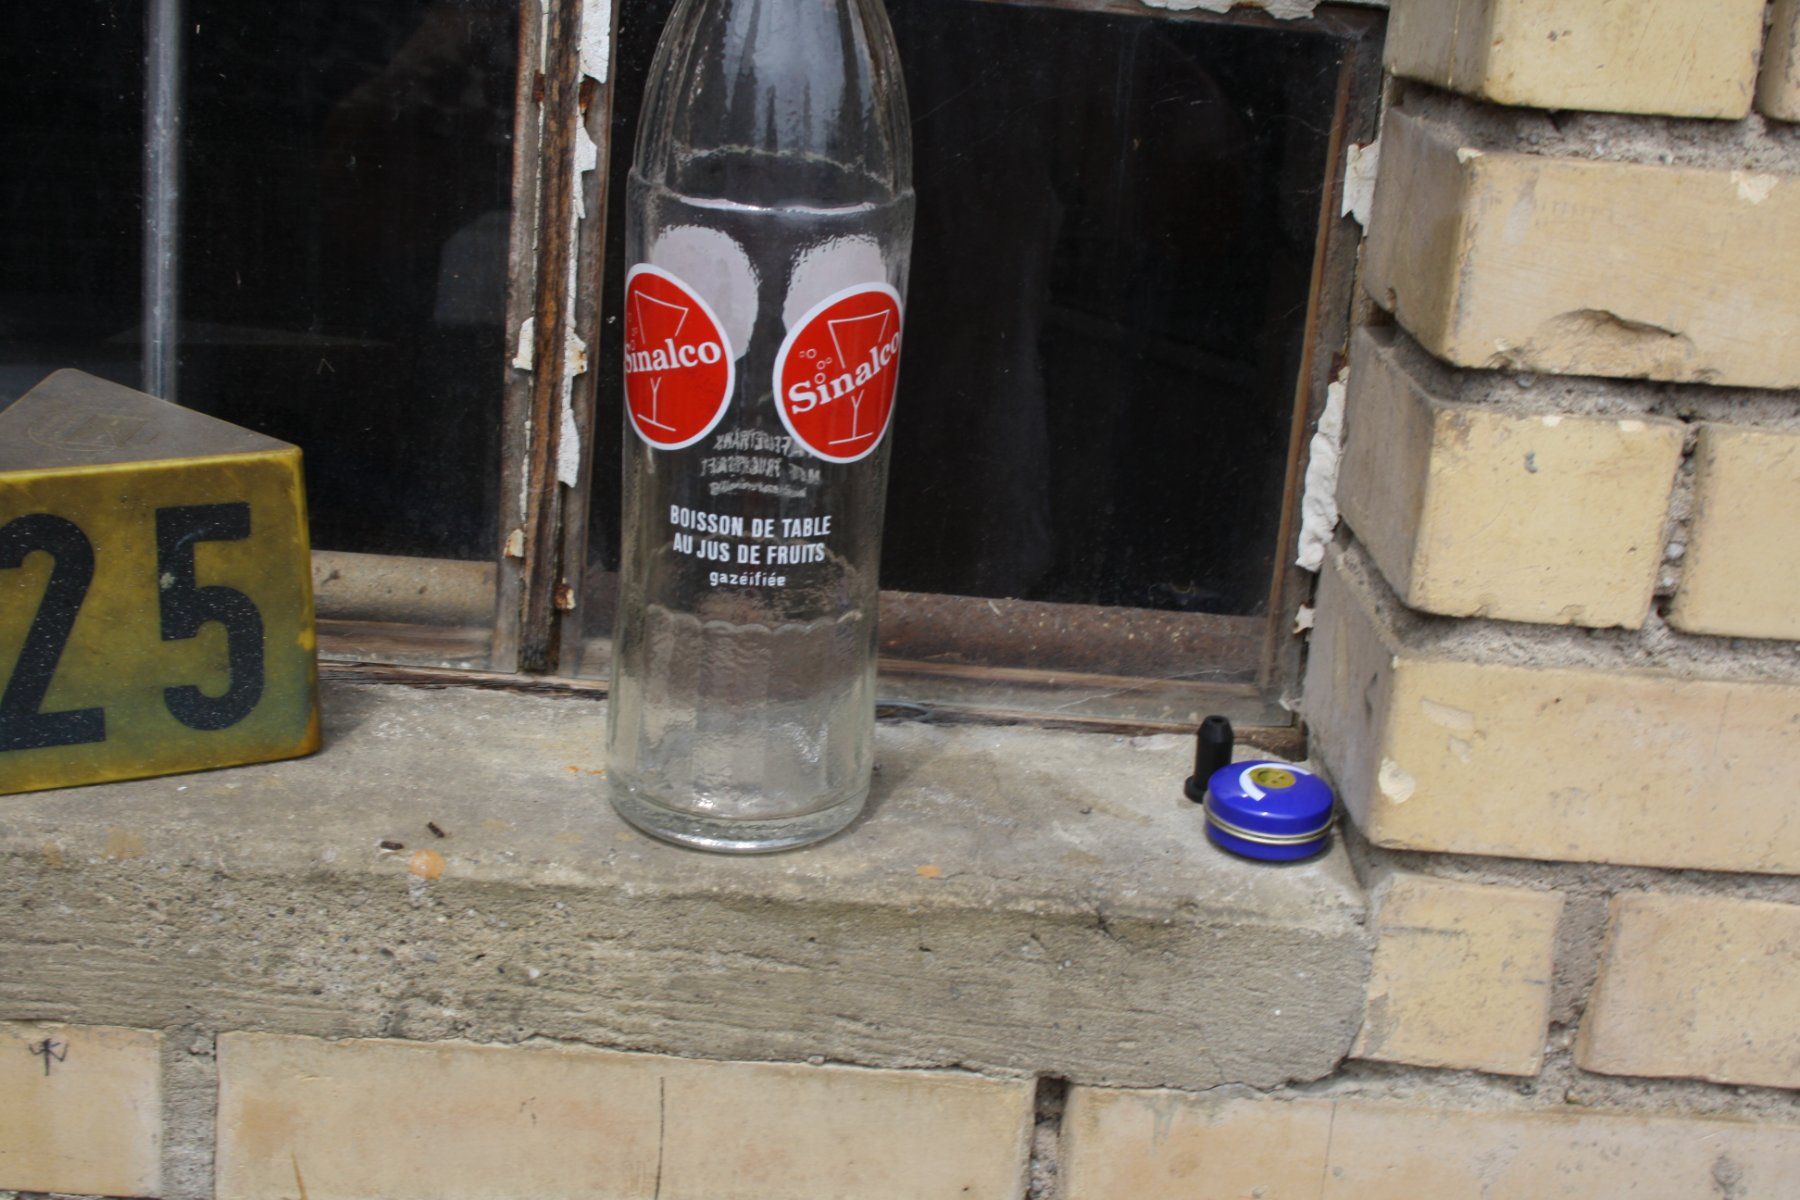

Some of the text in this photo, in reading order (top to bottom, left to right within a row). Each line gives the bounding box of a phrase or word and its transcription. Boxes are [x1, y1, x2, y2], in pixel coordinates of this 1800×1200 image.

[624, 338, 721, 374] Sinalco
[788, 331, 901, 415] Sinalco
[670, 504, 832, 538] BOISSON DE TABLE
[673, 532, 826, 565] AU JUS DE FRUITS
[0, 502, 265, 752] 25
